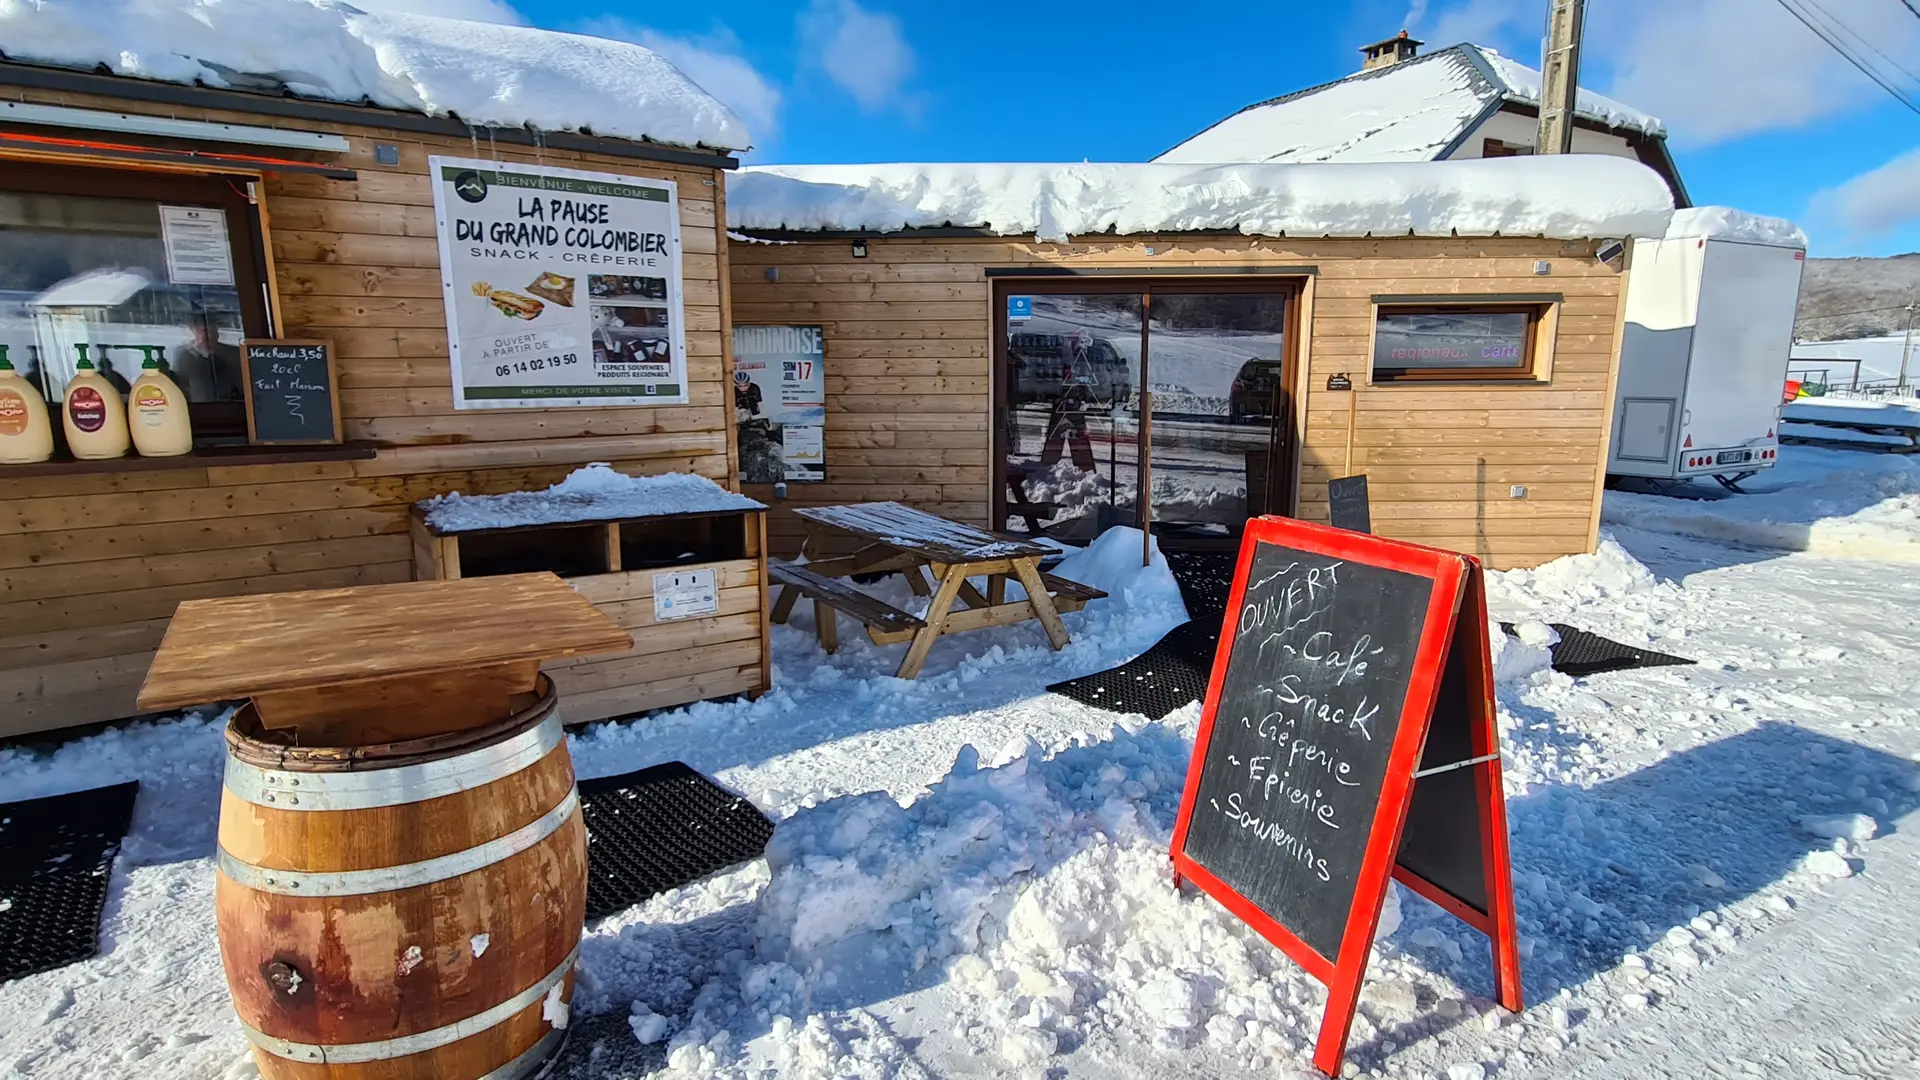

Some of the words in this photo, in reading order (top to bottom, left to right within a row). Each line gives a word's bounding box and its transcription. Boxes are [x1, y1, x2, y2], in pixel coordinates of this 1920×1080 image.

[497, 174, 573, 191] BIENVENUE
[588, 184, 649, 199] WELCOME
[518, 197, 544, 222] LA
[550, 199, 609, 225] PAUSE
[456, 219, 483, 242] DU
[490, 222, 558, 248] GRAND
[565, 227, 668, 256] COLOMBIER
[471, 248, 540, 260] SNACK
[563, 253, 657, 268] CRÊPERIE
[494, 334, 537, 348] OUVERT
[494, 343, 533, 357] PARTIR
[536, 340, 549, 350] DE
[496, 365, 510, 377] 06
[513, 362, 527, 374] 14
[530, 359, 545, 371] 02
[547, 356, 561, 369] 19
[563, 353, 577, 365] 50
[797, 361, 812, 380] 17
[255, 379, 280, 390] Fait
[290, 378, 324, 391] Maison
[570, 386, 601, 394] VOTRE
[1241, 561, 1343, 635] OUVERT
